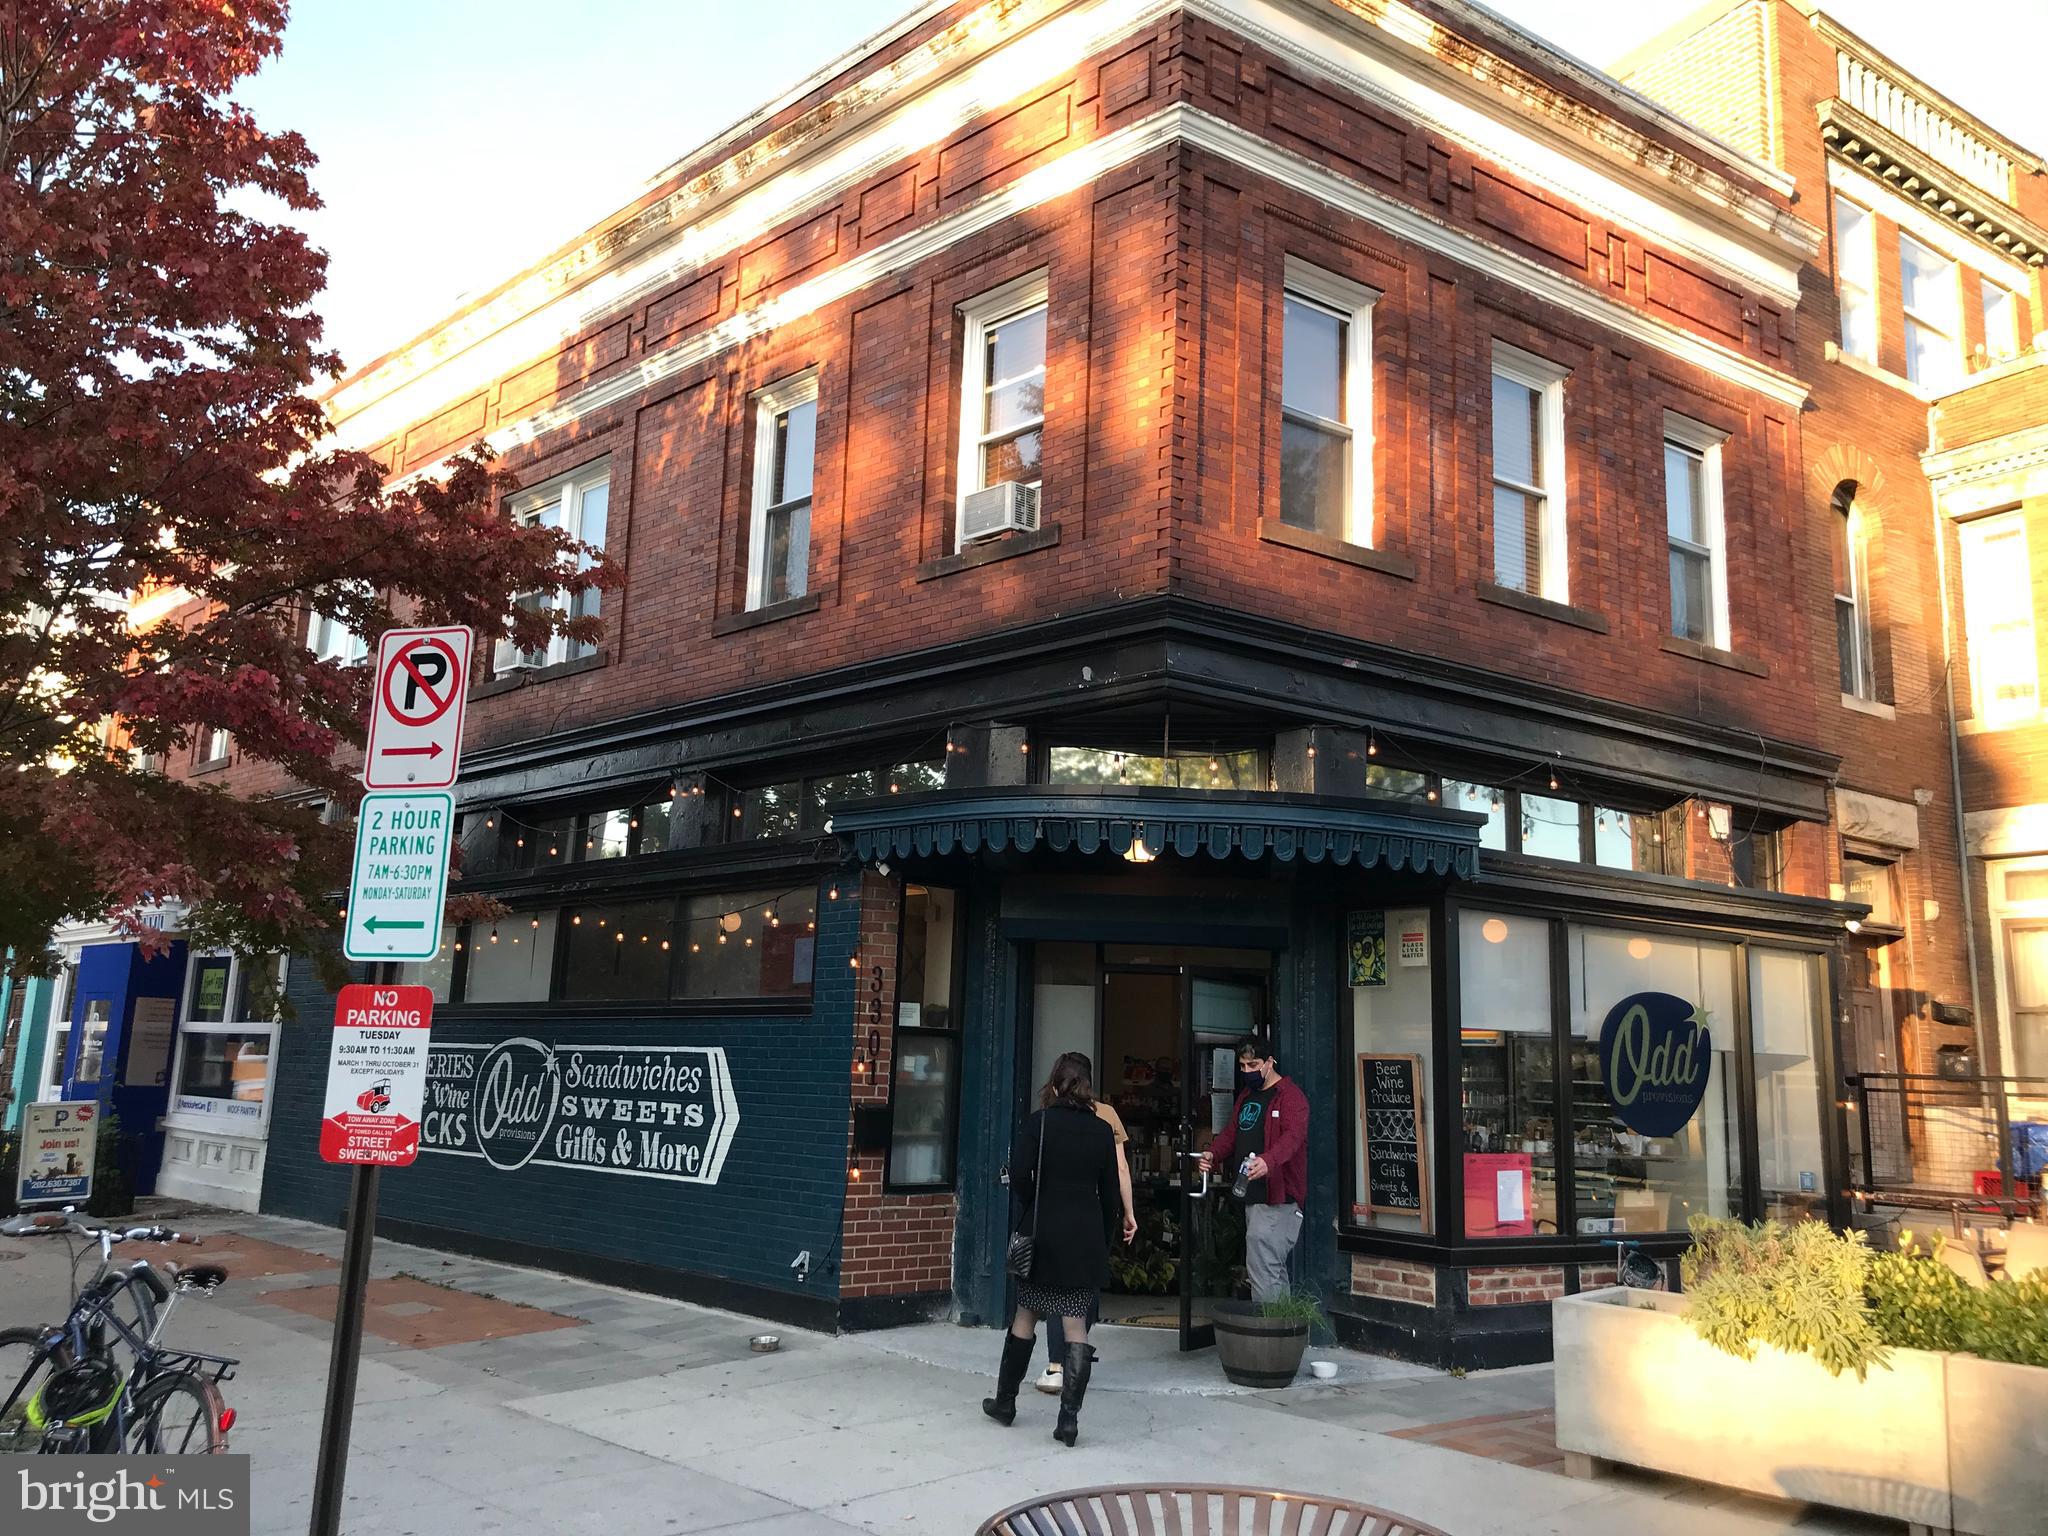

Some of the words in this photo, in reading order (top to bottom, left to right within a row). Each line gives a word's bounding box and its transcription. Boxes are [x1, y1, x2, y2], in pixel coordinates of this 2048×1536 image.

[372, 811, 383, 830] 2
[391, 809, 441, 830] HOUR
[369, 836, 435, 856] PARKING
[368, 864, 432, 881] 7AM-6:30PM
[362, 886, 432, 900] MONDAY-SATURDAY
[373, 990, 398, 1007] NO
[347, 1009, 421, 1027] PARKING
[359, 1030, 401, 1040] TUESDAY
[338, 1045, 367, 1054] 9:30AM
[370, 1046, 380, 1054] TO
[382, 1046, 415, 1055] 11:30AM
[1610, 1003, 1699, 1106] Odd
[425, 1053, 475, 1079] ERIES
[565, 1051, 703, 1094] Sandwiches
[1375, 1061, 1401, 1075] Beer
[1376, 1076, 1404, 1089] Wine
[432, 1081, 470, 1109] Wine
[480, 1052, 545, 1139] Odd
[1371, 1088, 1411, 1104] Produce
[561, 1095, 704, 1127] SWEETS
[380, 1117, 397, 1125] ZONE
[423, 1111, 468, 1146] CKS
[348, 1136, 391, 1148] STREET
[499, 1127, 536, 1141] provisions
[39, 1139, 61, 1149] Join
[64, 1138, 80, 1148] us!
[555, 1123, 607, 1164] Gifts
[611, 1127, 632, 1166] &
[636, 1130, 700, 1173] More
[339, 1148, 397, 1162] SWEEPING
[1380, 1163, 1406, 1178] Gifts
[1371, 1179, 1398, 1192] Sweets
[1401, 1180, 1409, 1192] &
[1389, 1192, 1420, 1207] Snacks
